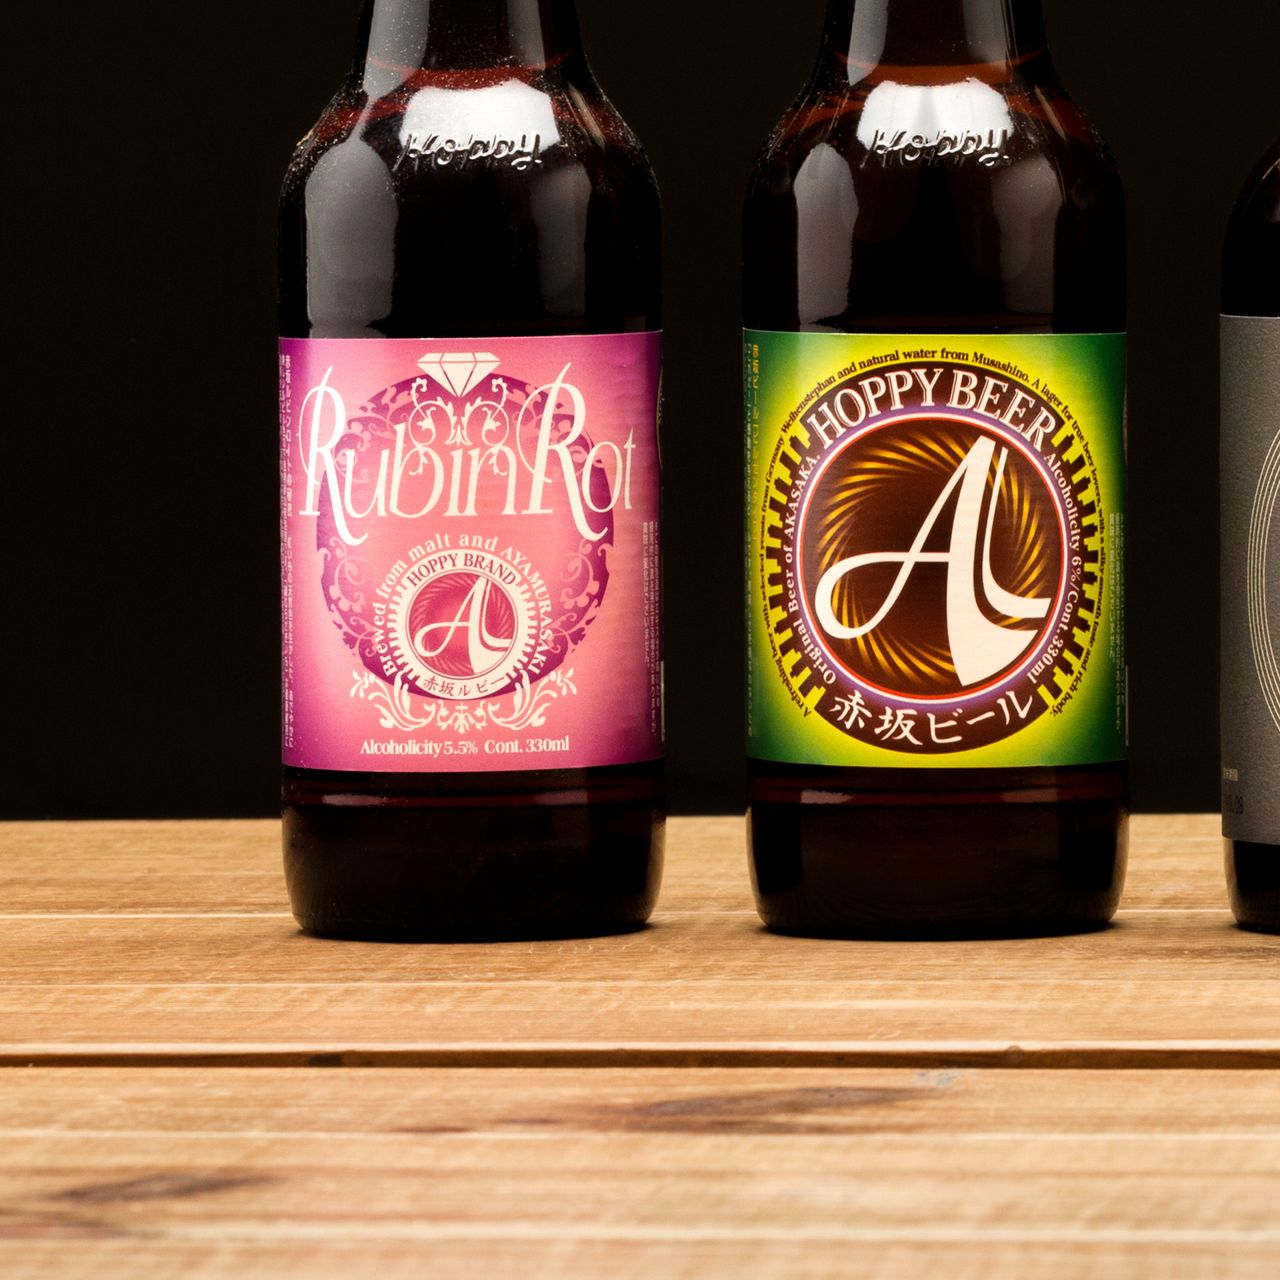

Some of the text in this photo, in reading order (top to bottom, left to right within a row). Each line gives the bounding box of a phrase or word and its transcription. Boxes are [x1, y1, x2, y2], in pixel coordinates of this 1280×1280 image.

[858, 349, 900, 371] natural
[902, 347, 938, 360] water
[940, 347, 969, 361] from
[836, 361, 858, 380] and
[972, 351, 1030, 384] Musashino.
[1032, 378, 1041, 390] A
[1040, 383, 1063, 409] lager
[806, 368, 944, 450] HOPPY
[946, 369, 1057, 452] BEER
[1061, 405, 1074, 422] for
[1071, 420, 1084, 443] true
[298, 365, 517, 546] Rubin
[516, 361, 636, 542] Rot
[1082, 441, 1095, 468] beer
[1043, 453, 1081, 552] Alcoholicity
[406, 552, 517, 588] HOPPY BRAND
[783, 454, 837, 685] Original Beer of AKASAKA.
[372, 532, 553, 678] Brewed from malt and AYAMURASAKI
[422, 675, 505, 698] 赤坂ルビー
[1071, 667, 1084, 693] rich
[1050, 690, 1074, 718] body.
[828, 689, 1034, 746] 赤坂ビール
[360, 736, 570, 758] Alcoholicity 5.5% Cont. 330ml
